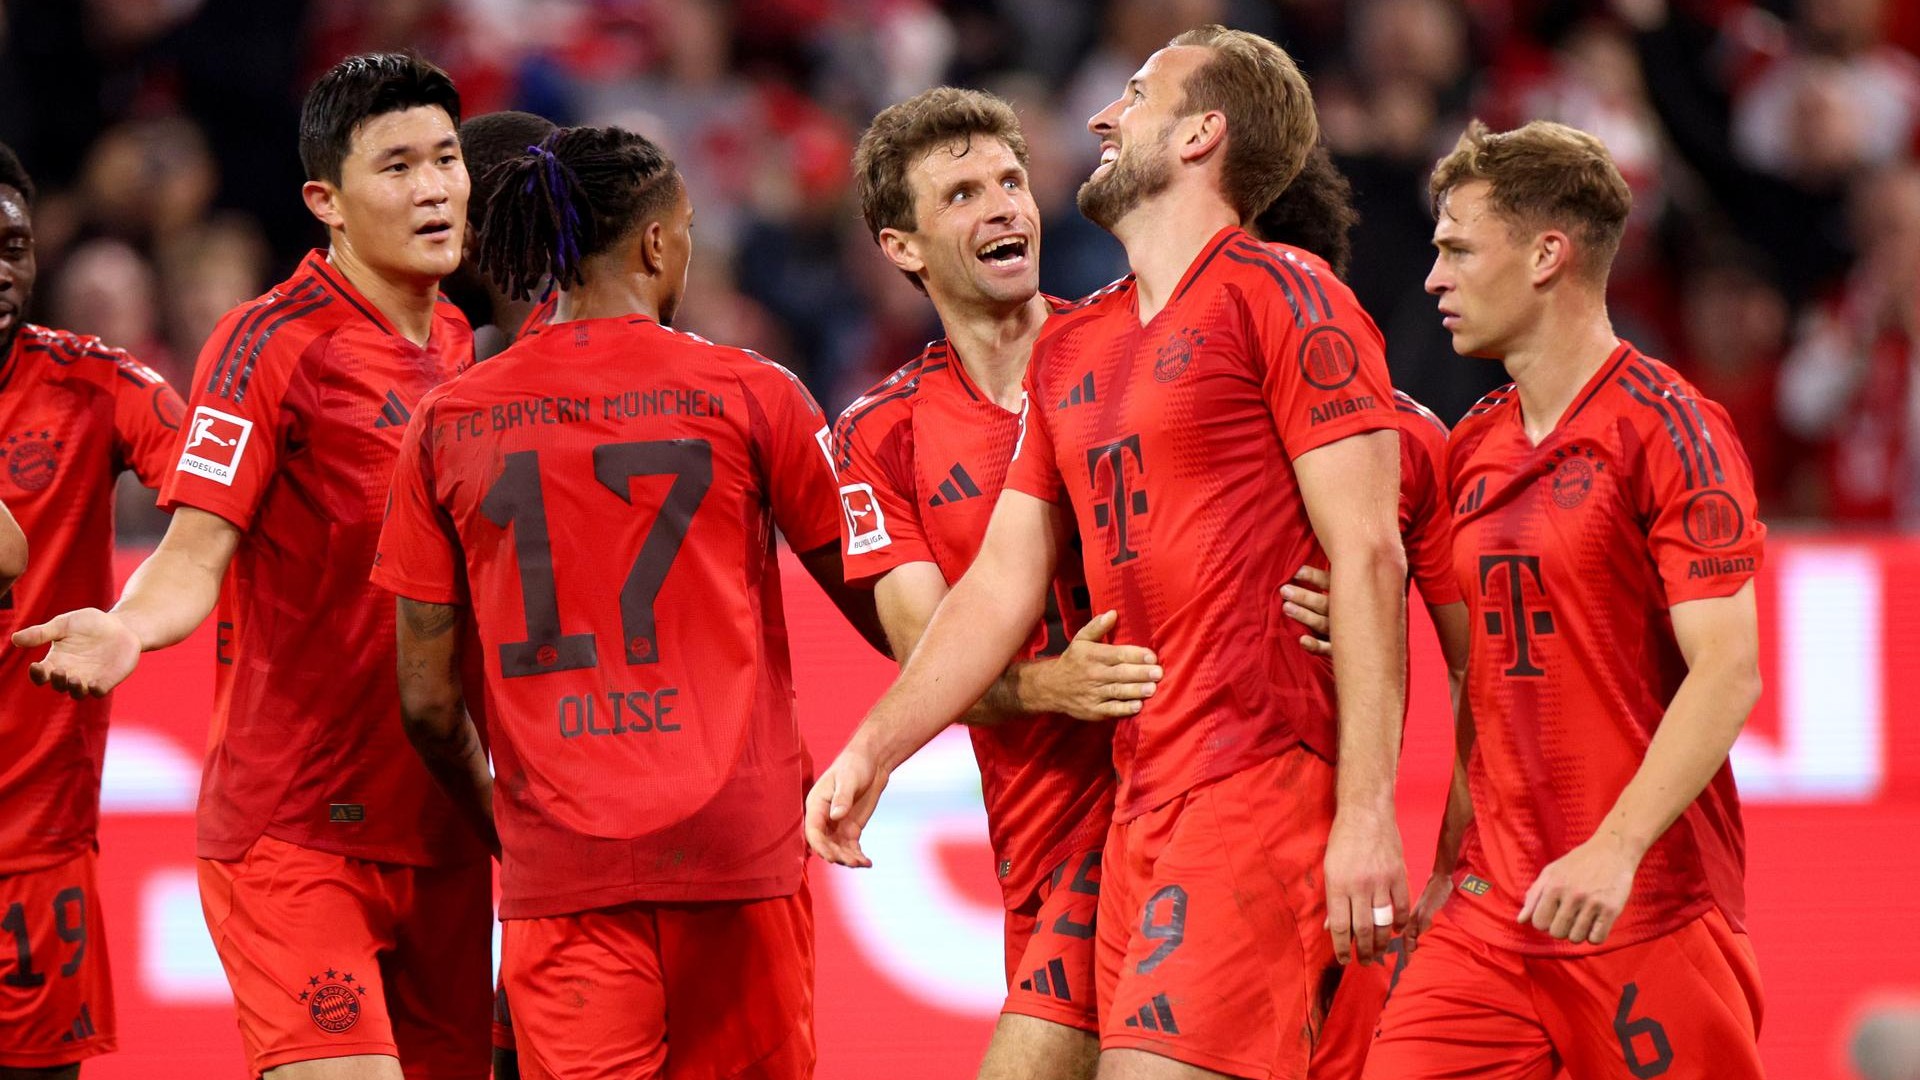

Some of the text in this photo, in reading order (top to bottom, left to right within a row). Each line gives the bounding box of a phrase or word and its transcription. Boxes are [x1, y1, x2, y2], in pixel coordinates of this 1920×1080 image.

[456, 388, 725, 442] FC BAYERN MÜNCHEN
[1310, 394, 1377, 427] Allianz
[480, 437, 714, 679] 17
[1688, 556, 1756, 580] Allianz
[558, 687, 682, 738] OLISE
[1, 885, 86, 988] 19
[1137, 885, 1187, 975] 9
[1612, 981, 1674, 1080] 6
